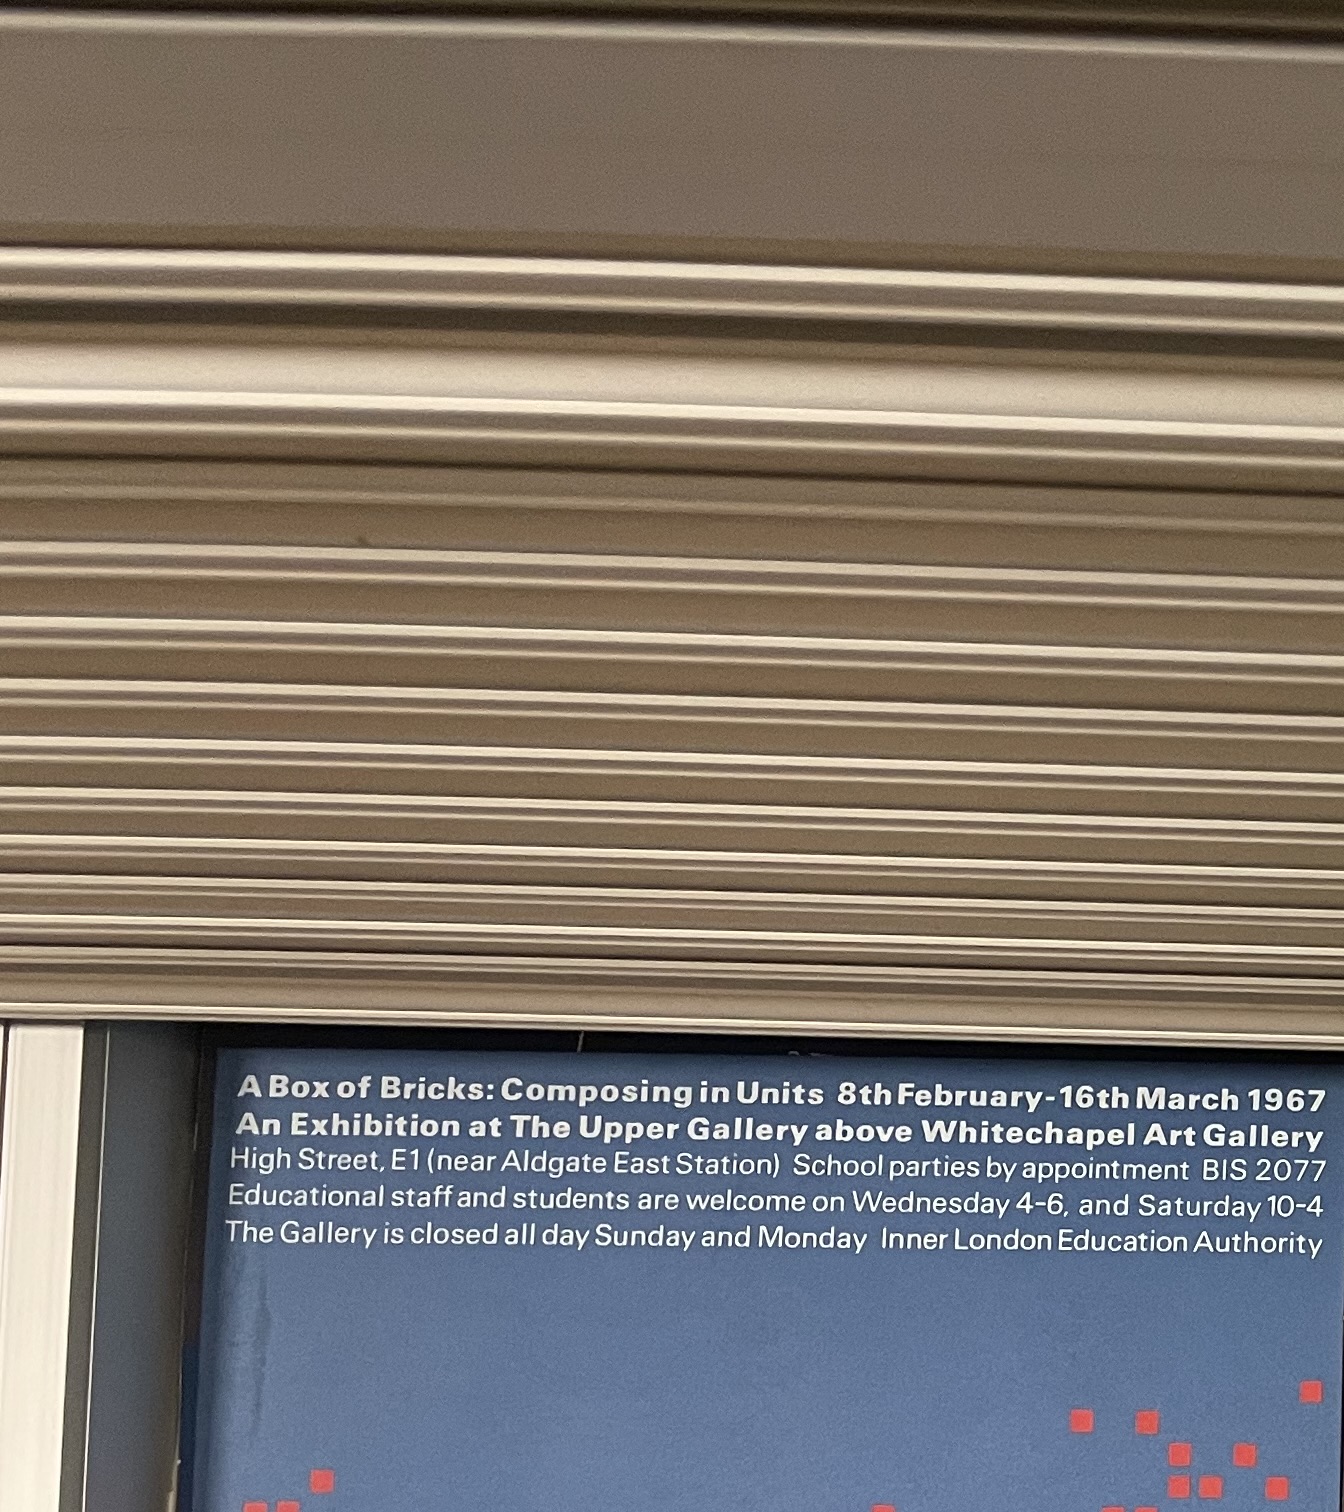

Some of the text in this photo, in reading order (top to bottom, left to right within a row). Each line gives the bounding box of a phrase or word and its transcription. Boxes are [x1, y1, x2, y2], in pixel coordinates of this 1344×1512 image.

[237, 1074, 263, 1098] A
[268, 1074, 330, 1098] Box
[336, 1075, 372, 1099] of
[380, 1075, 494, 1101] Bricks:
[501, 1077, 693, 1109] Composing
[699, 1080, 730, 1104] in
[736, 1080, 824, 1105] Units
[837, 1081, 892, 1106] 8th
[1136, 1086, 1239, 1111] March
[1247, 1088, 1326, 1112] 1967
[235, 1111, 1324, 1153] An Exhibition at The Upper Gallery above Whitechapel Art Gallery
[231, 1146, 1327, 1184] High Street, E1 (near Aldgate East Station) School parties by appointment BIS 2077
[228, 1183, 1324, 1223] Educational staff and students are welcome on Wednesday 4-6, and Saturday 10-4
[225, 1219, 1323, 1260] The Gallery is closed all day Sunday and Monday Inner London Education Authority
